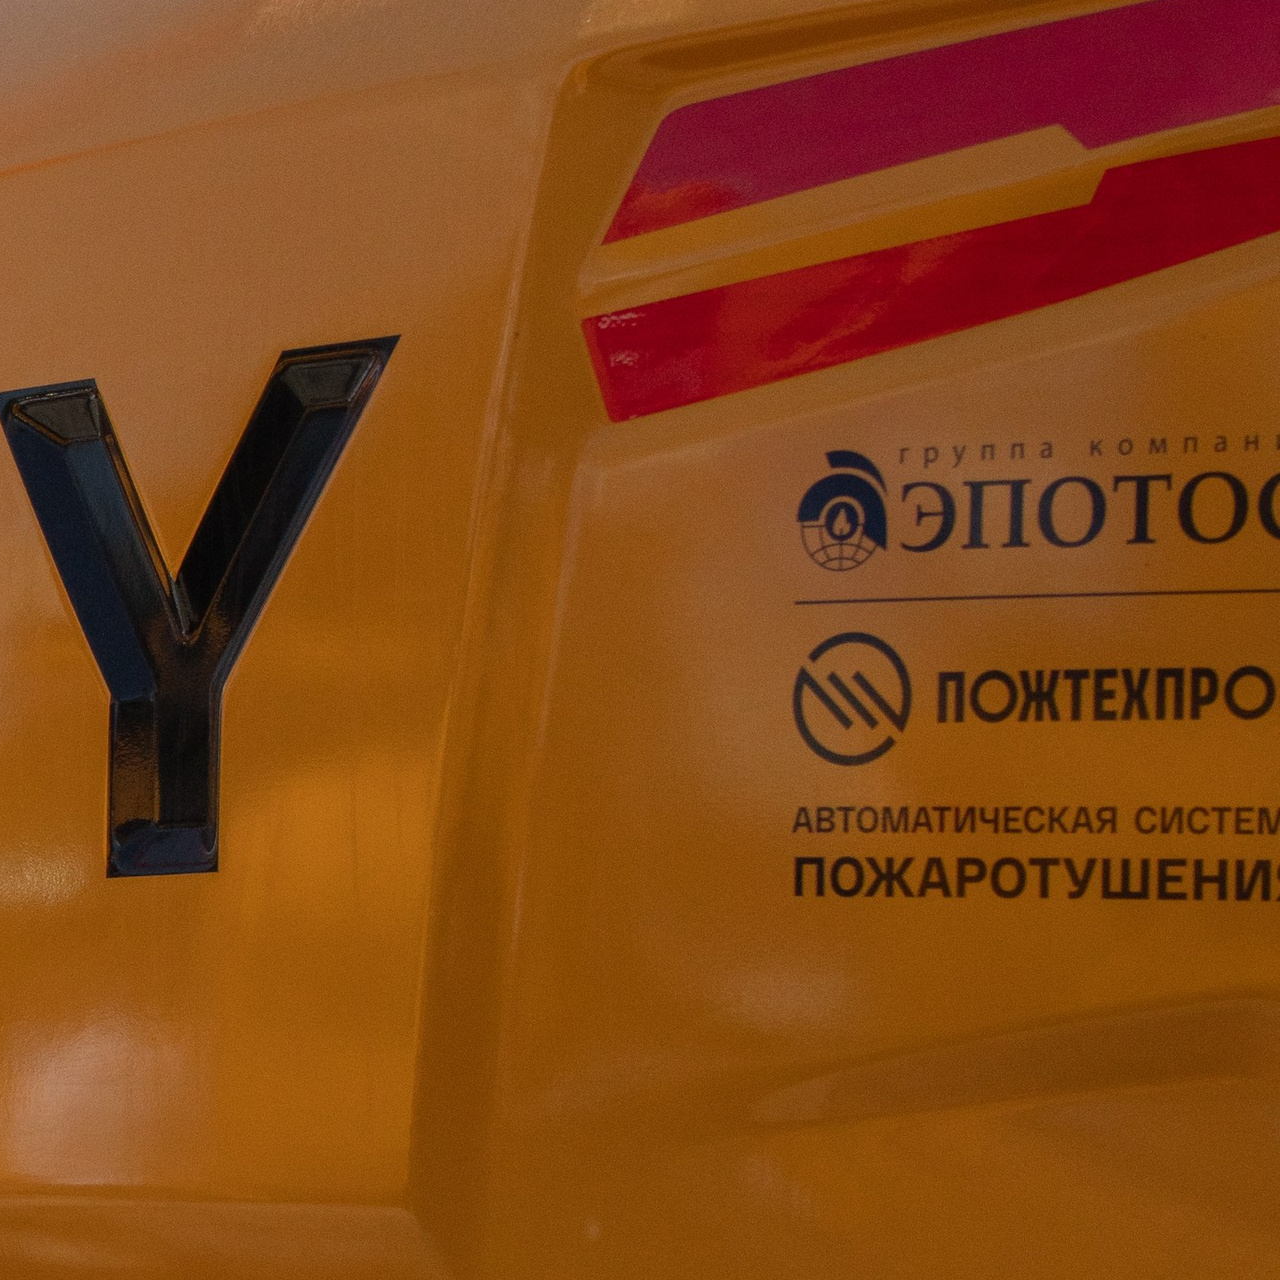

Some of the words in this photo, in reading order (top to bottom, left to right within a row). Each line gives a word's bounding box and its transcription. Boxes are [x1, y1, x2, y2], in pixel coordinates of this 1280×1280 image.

[898, 440, 1054, 470] группа
[1089, 433, 1280, 458] компан
[937, 665, 1276, 724] ПОЖТЕХПРО
[792, 806, 1119, 834] АВТОМАТИЧЕСКАЯ
[793, 856, 1280, 902] ПОЖАРОТУШЕНИ
